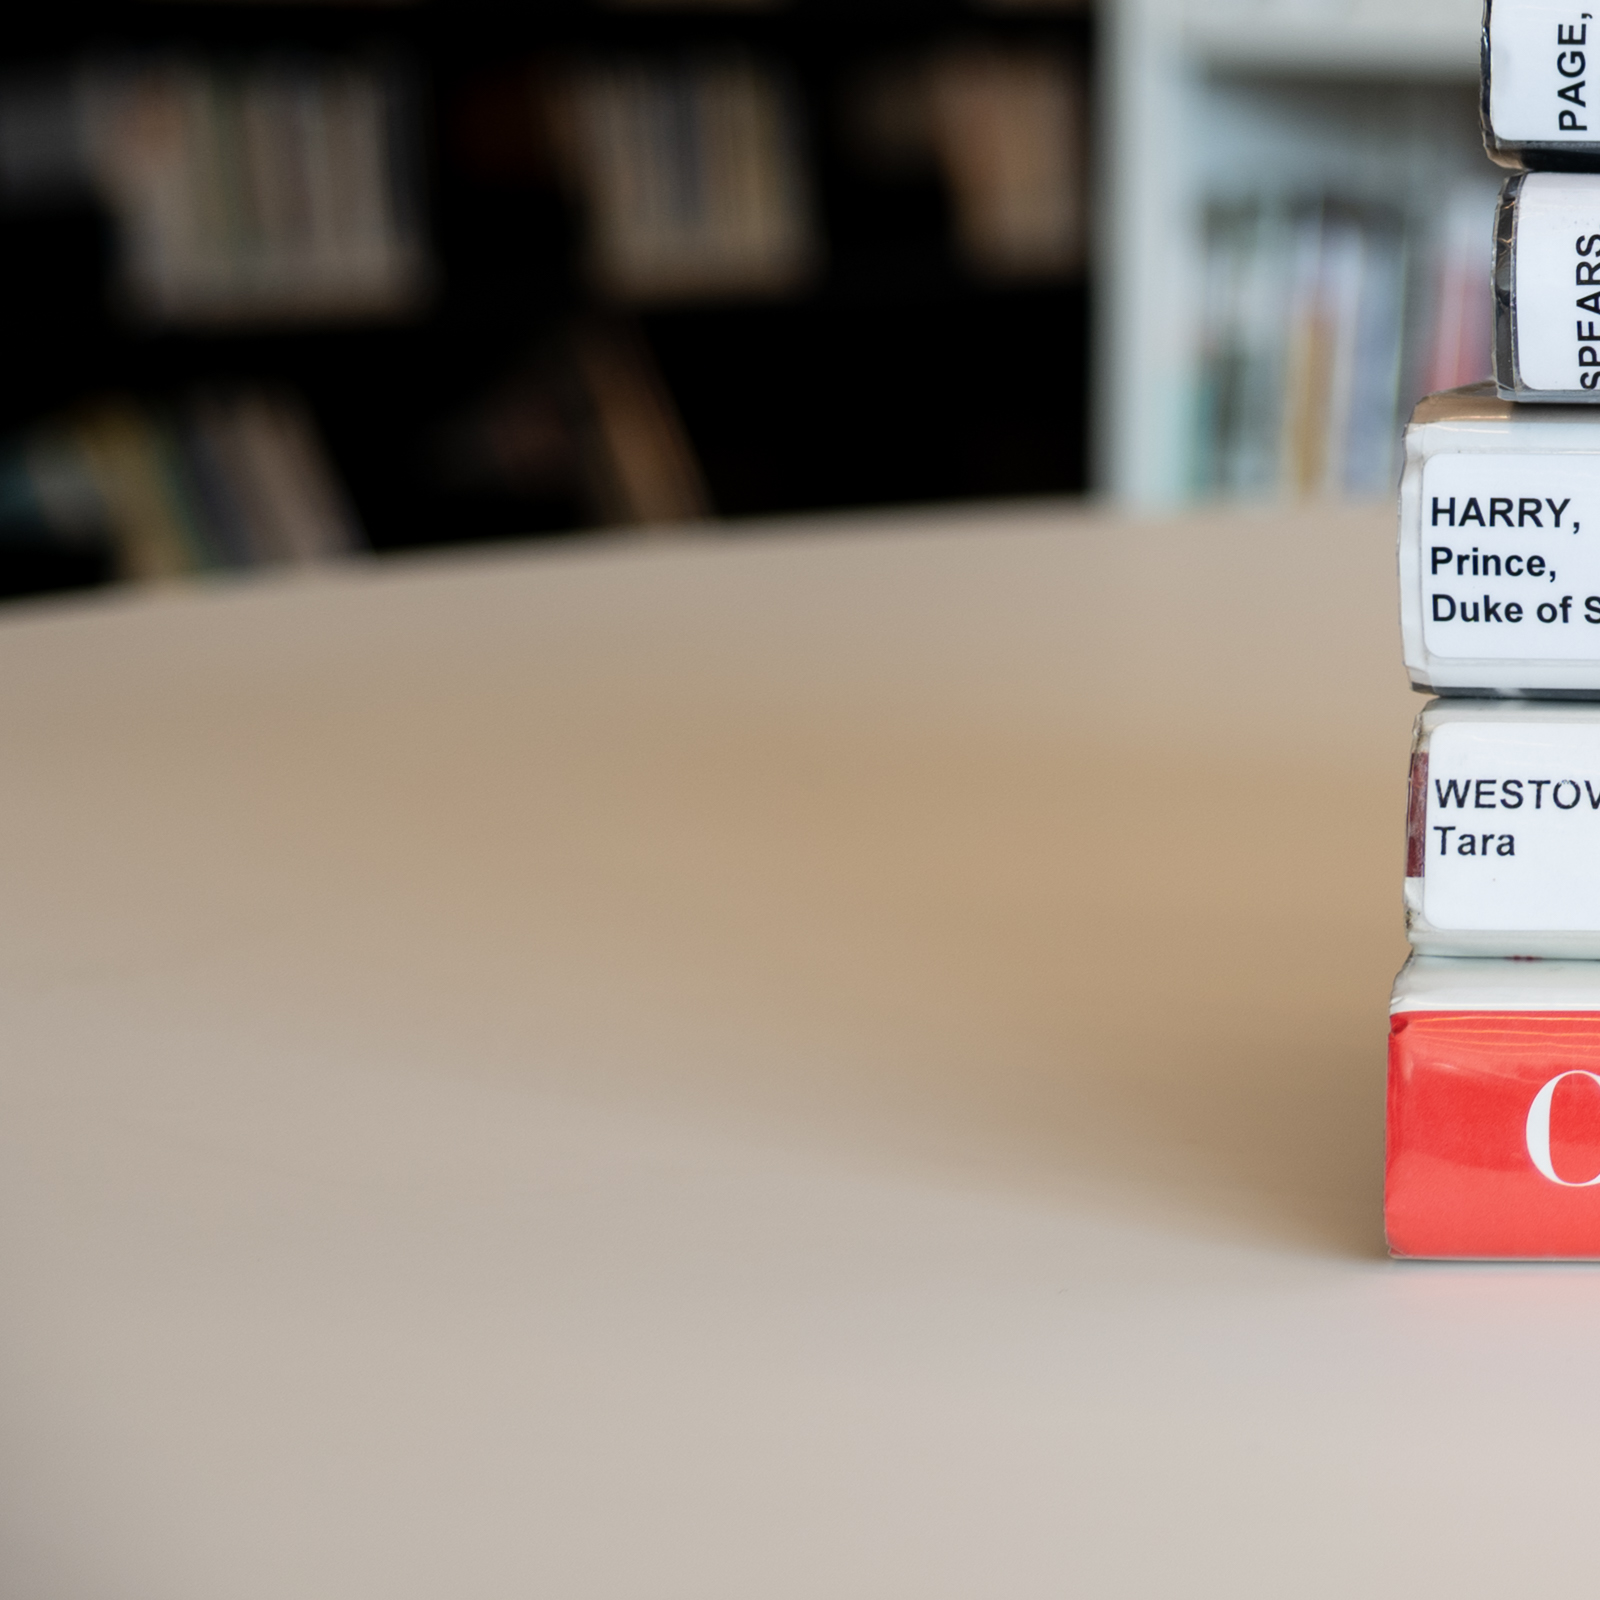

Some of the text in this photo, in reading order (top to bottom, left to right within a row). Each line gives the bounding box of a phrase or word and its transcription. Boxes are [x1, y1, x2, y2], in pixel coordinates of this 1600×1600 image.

[1557, 14, 1592, 130] PAGE,
[1432, 497, 1579, 534] HARRY,
[1432, 547, 1555, 582] Prince,
[1433, 594, 1522, 623] Duke
[1537, 596, 1572, 623] of
[1434, 826, 1514, 856] Tara
